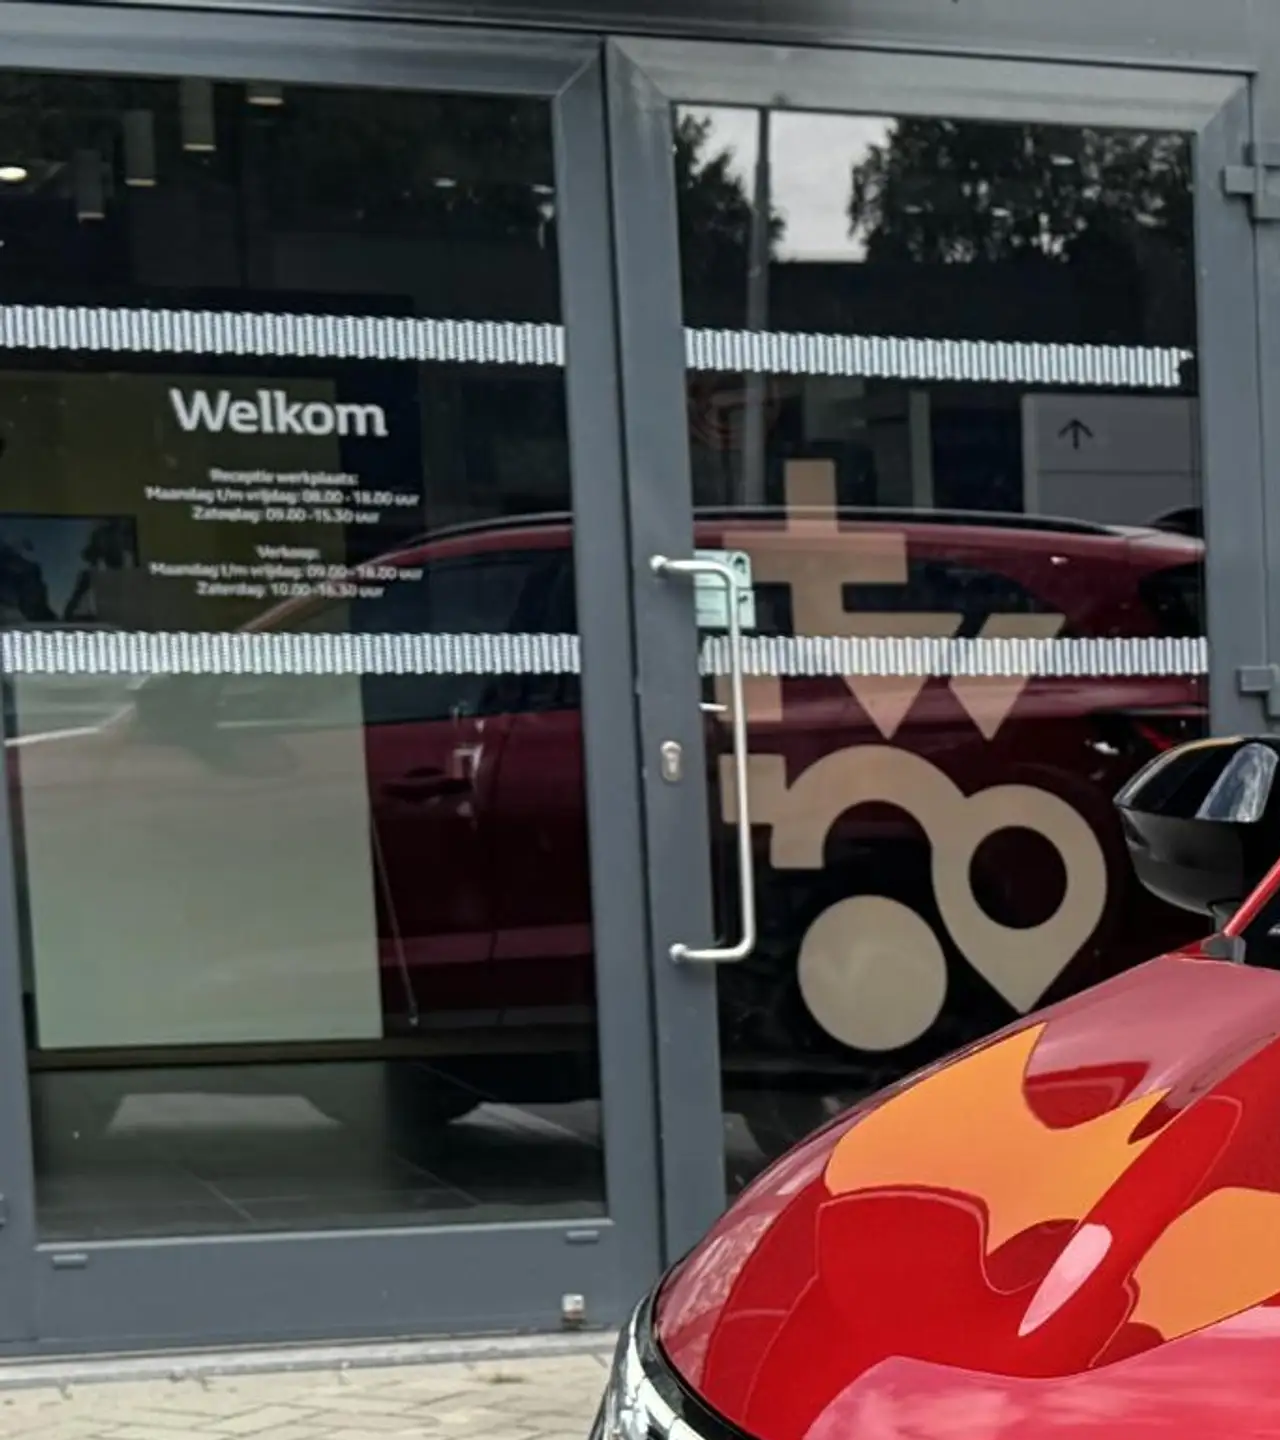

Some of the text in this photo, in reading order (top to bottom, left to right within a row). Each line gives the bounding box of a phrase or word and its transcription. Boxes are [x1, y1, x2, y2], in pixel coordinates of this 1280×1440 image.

[168, 386, 389, 438] Welkom
[144, 486, 214, 503] Maandag
[216, 488, 243, 501] t/m
[395, 494, 419, 505] uur
[355, 512, 379, 523] uur
[150, 562, 218, 579] Maandag
[220, 563, 248, 578] t/m
[399, 568, 422, 580] uur
[359, 587, 384, 598] uur
